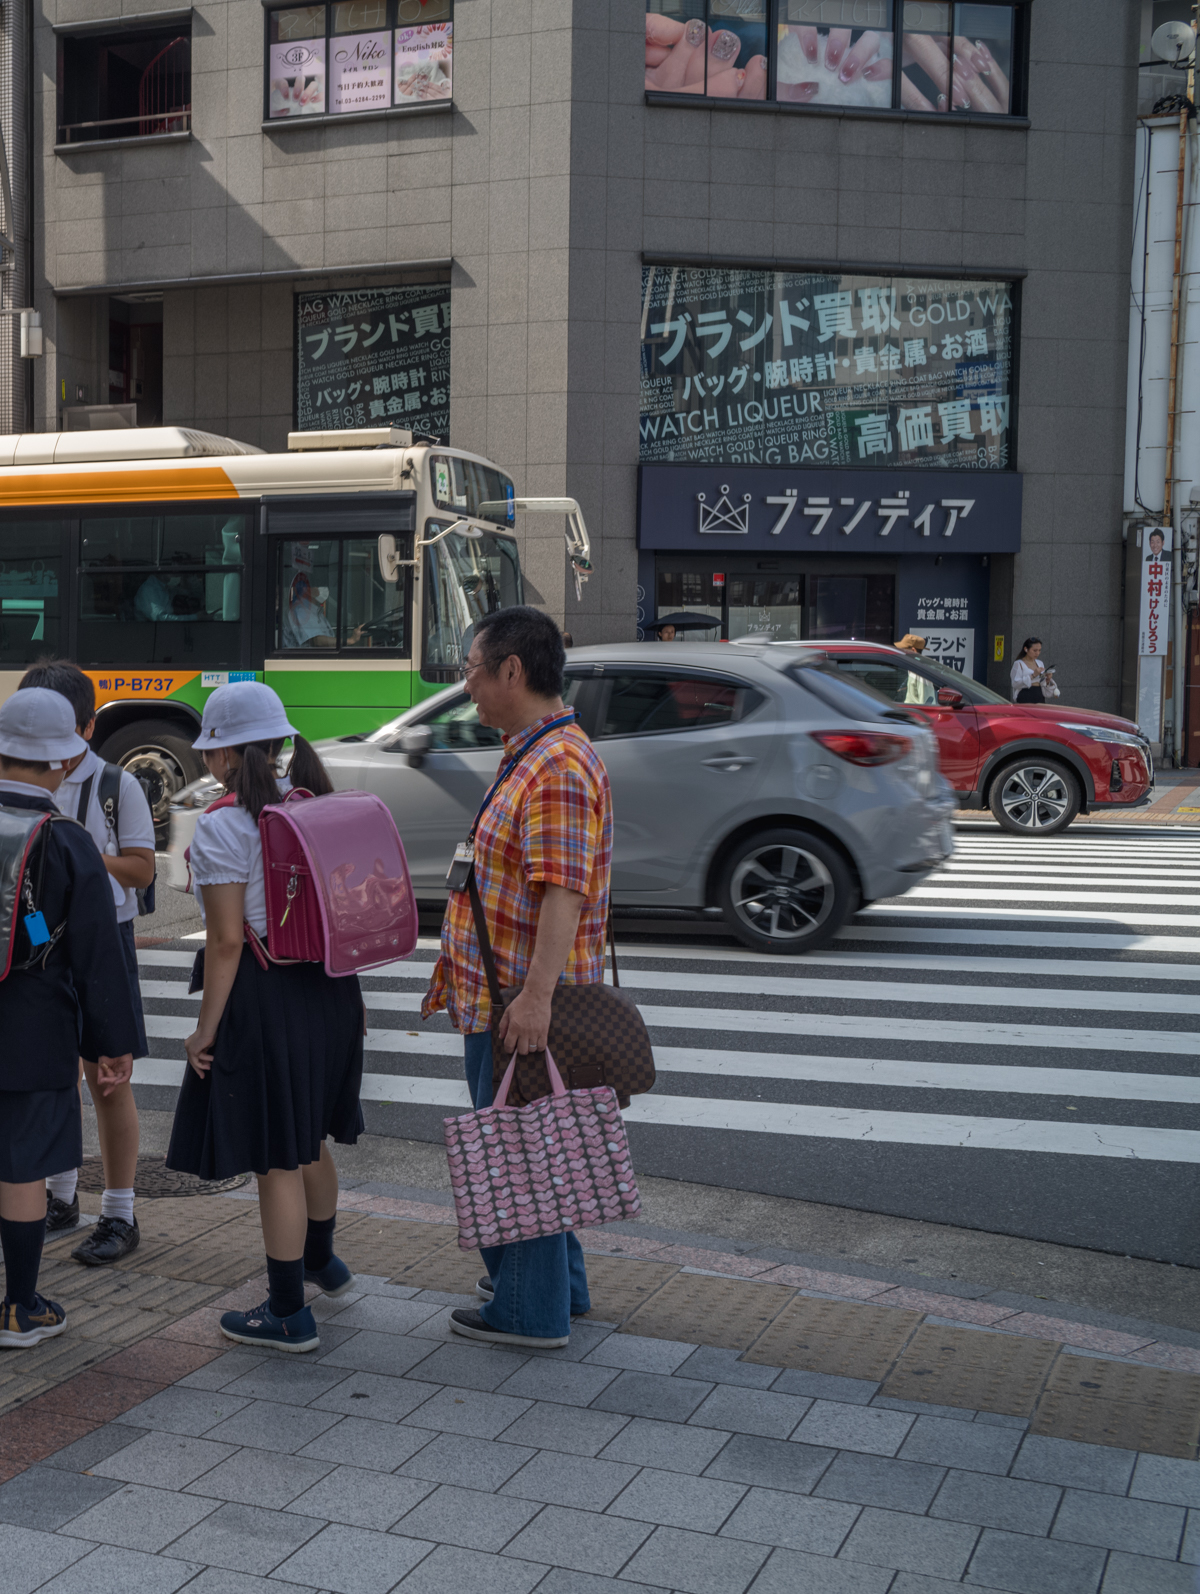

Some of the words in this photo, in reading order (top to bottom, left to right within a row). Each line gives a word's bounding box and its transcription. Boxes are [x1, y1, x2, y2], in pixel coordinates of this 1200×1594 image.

[335, 40, 386, 64] Niko
[650, 286, 901, 366] ブランド買取
[909, 300, 971, 327] GOLD
[312, 374, 335, 385] WATCH
[336, 370, 356, 380] GOLD
[385, 356, 420, 369] NECKLACE
[421, 352, 438, 361] RING
[316, 367, 427, 407] バッグ・腕時計
[369, 386, 450, 420] 貴金属・お
[639, 406, 719, 441] WATCH
[727, 391, 823, 426] LIQUEUR
[826, 411, 836, 435] BAG
[854, 394, 1010, 459] 高価買取
[687, 445, 724, 460] WATCH
[726, 439, 755, 454] GOLD
[802, 427, 828, 441] RING
[787, 439, 830, 464] BAG
[765, 488, 977, 537] ブランディア
[1147, 561, 1164, 655] 中村けんじろう
